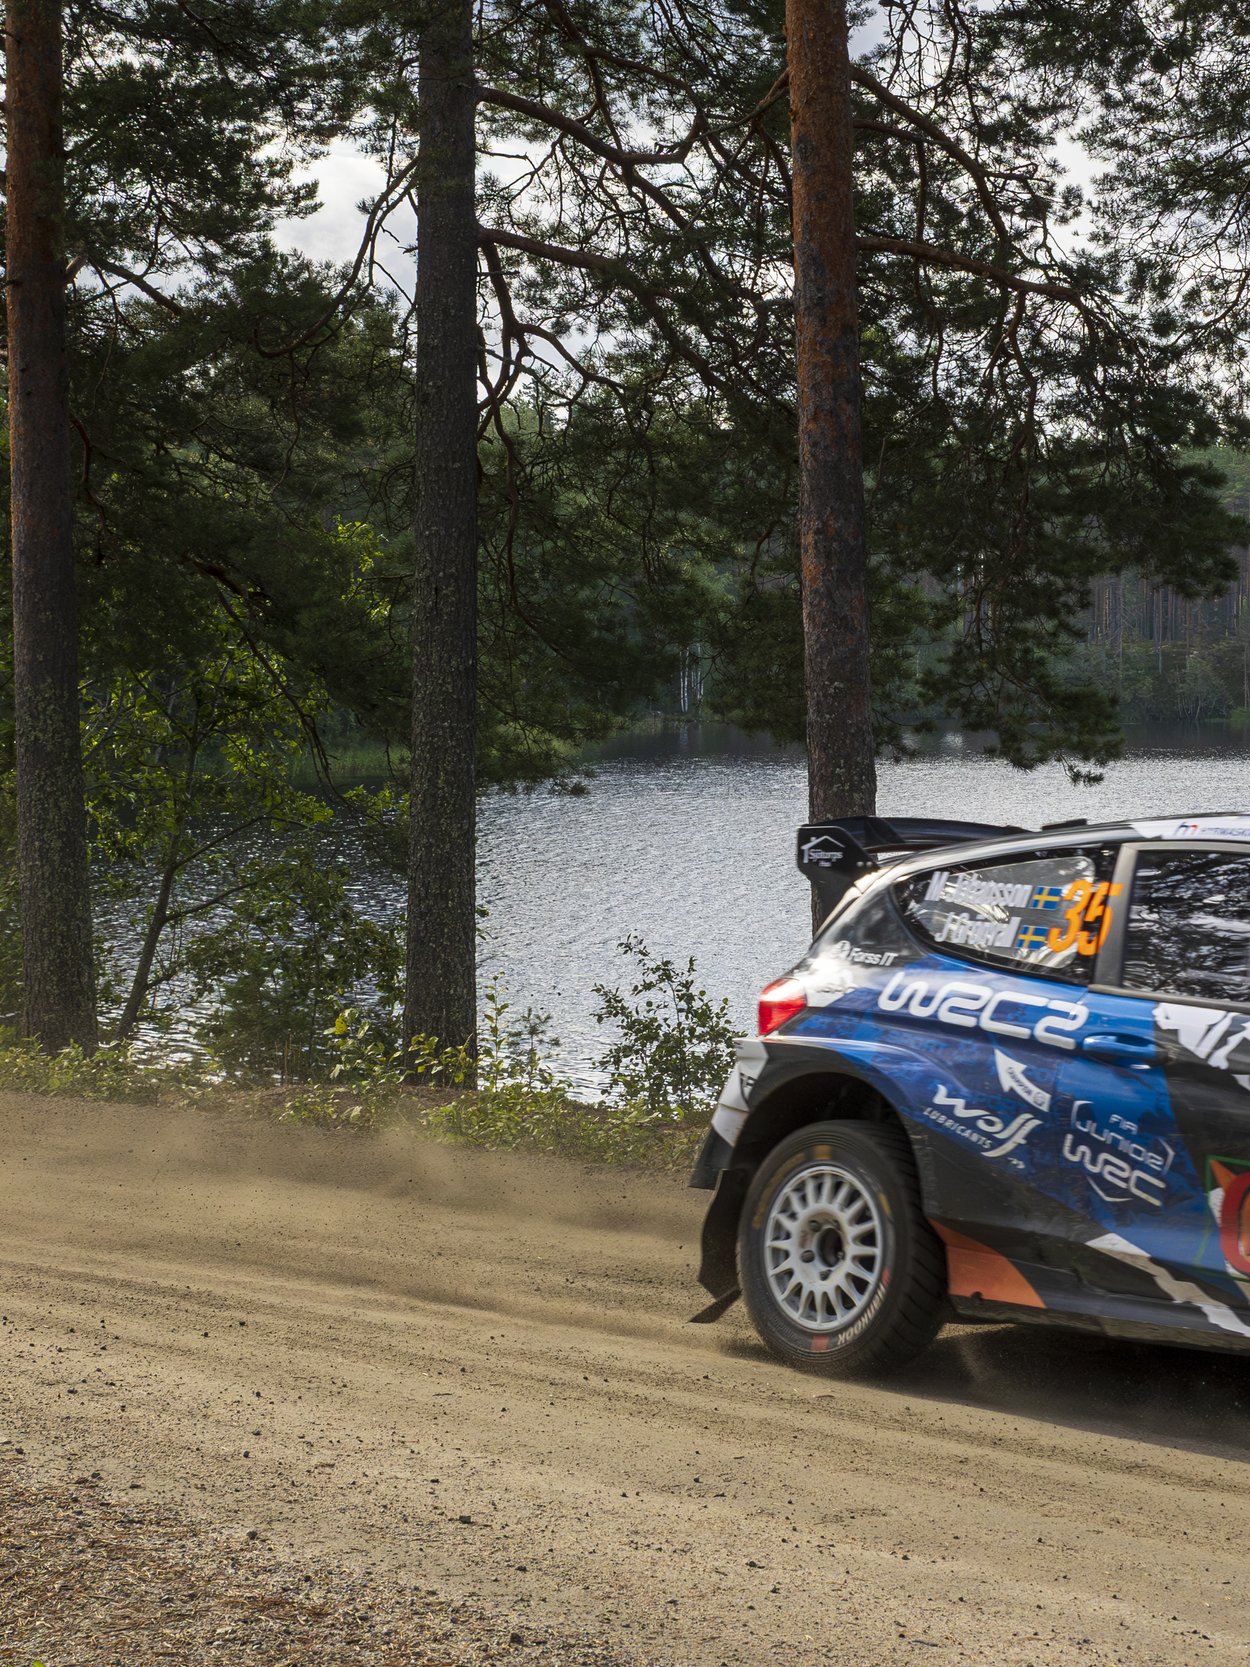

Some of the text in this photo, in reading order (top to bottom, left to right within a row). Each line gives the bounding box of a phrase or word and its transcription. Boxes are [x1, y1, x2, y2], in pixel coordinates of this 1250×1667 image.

[1047, 879, 1124, 956] 35
[878, 973, 1089, 1050] WRC2
[922, 1106, 995, 1150] LUBRICANTS
[1108, 1113, 1139, 1136] FIA
[1063, 1133, 1167, 1207] WRC
